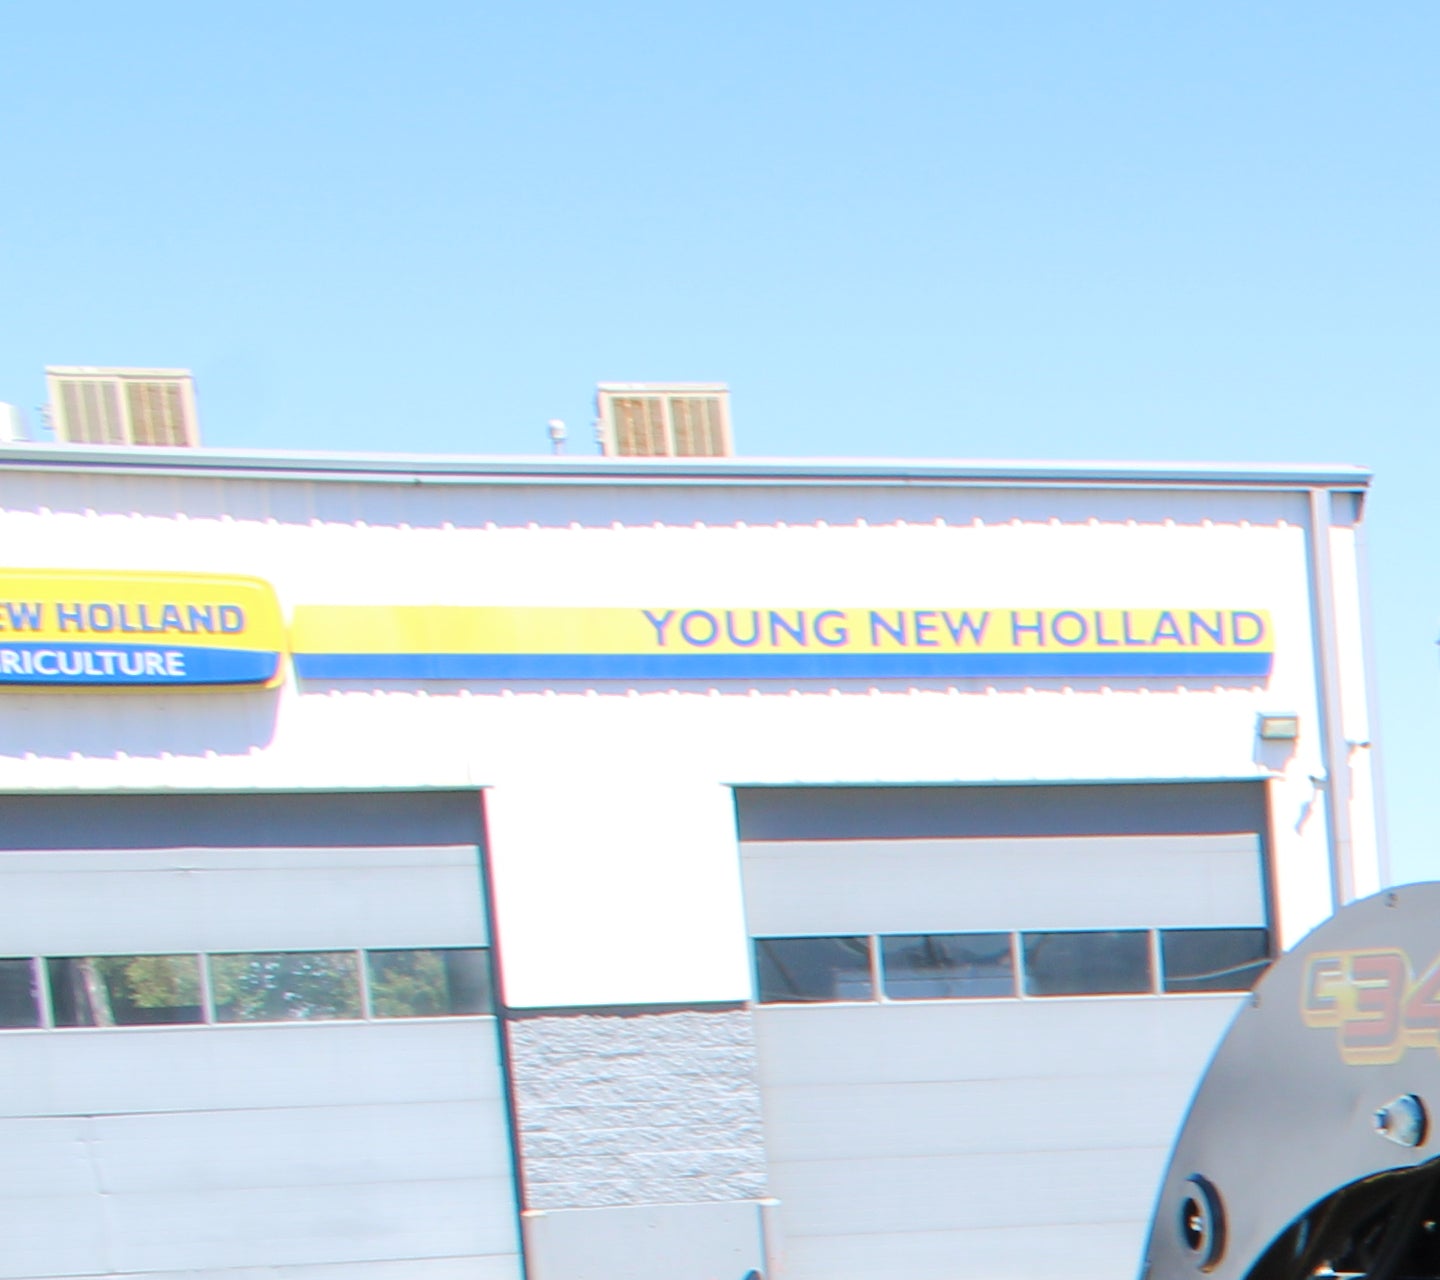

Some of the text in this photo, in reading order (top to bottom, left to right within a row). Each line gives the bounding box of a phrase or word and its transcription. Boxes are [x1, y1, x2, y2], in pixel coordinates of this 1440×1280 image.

[56, 602, 246, 635] HOLLAND
[641, 609, 1266, 647] YOUNG NEW HOLLAND
[0, 648, 187, 676] RICULTURE
